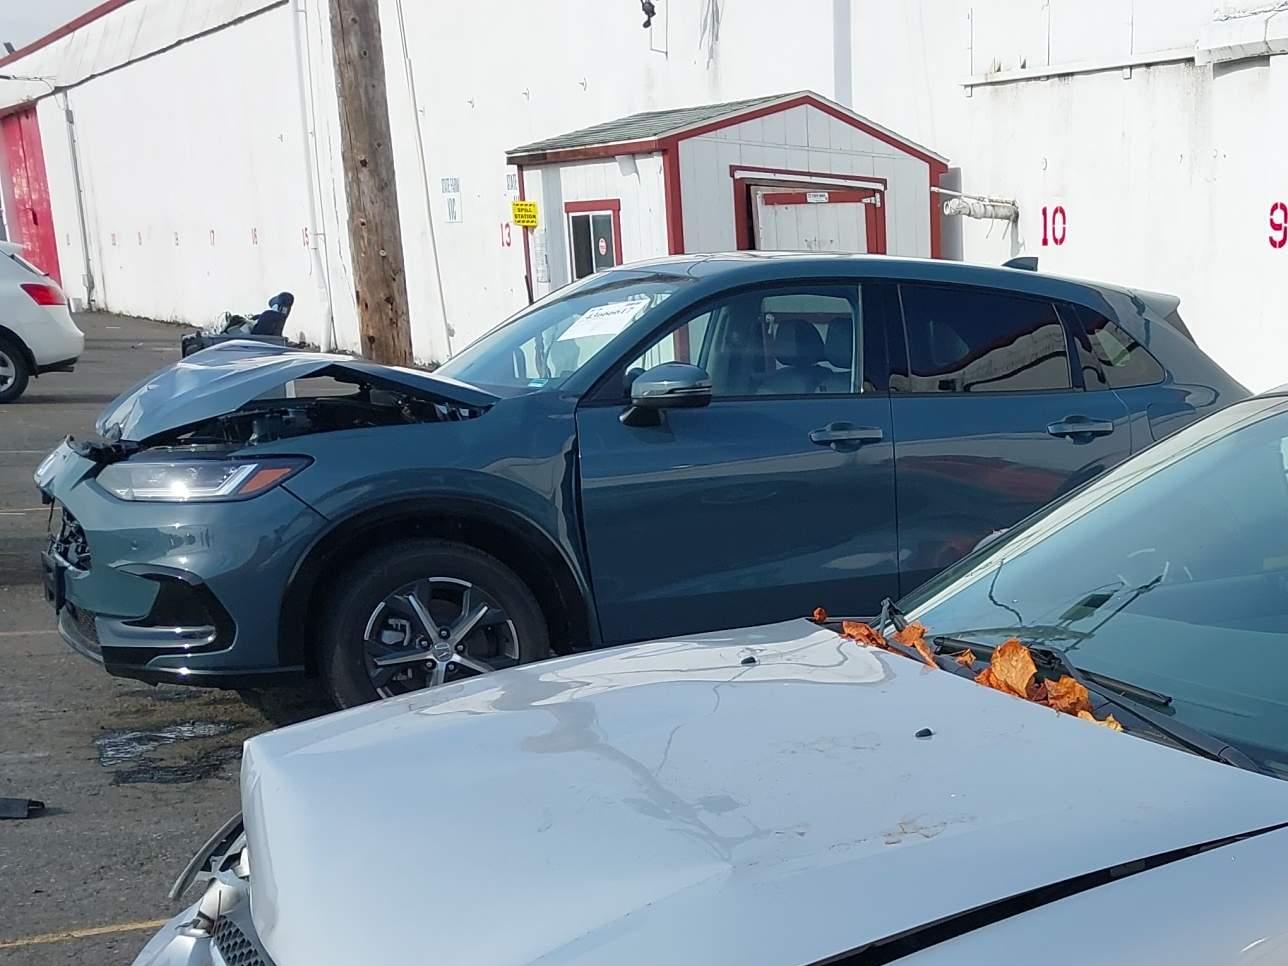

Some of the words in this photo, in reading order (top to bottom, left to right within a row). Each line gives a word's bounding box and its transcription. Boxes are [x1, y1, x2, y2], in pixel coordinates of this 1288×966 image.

[500, 223, 511, 247] 13
[1042, 205, 1067, 246] 10
[1268, 202, 1288, 249] 9
